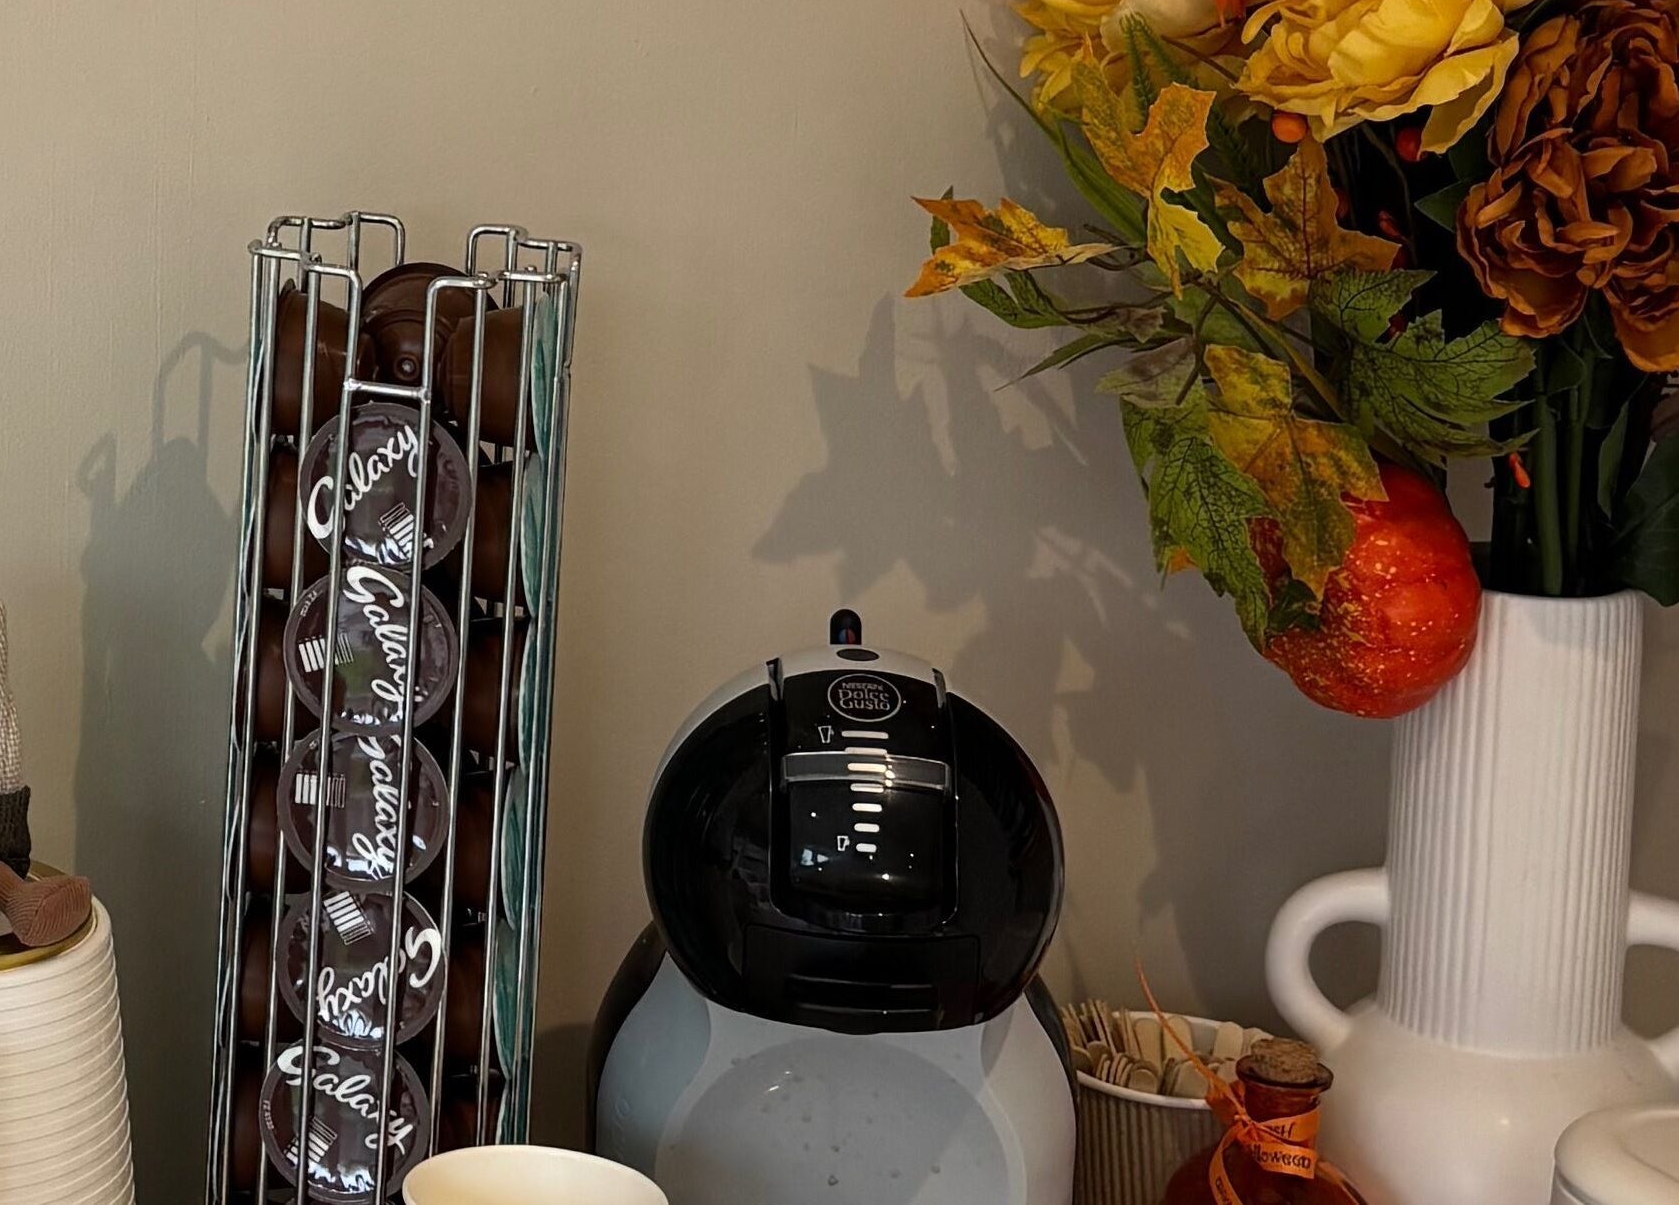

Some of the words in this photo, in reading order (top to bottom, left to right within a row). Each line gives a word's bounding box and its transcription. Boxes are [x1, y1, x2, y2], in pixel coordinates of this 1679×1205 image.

[307, 425, 420, 540] Galaxy
[838, 688, 890, 702] Dolce
[839, 698, 891, 711] Gusto
